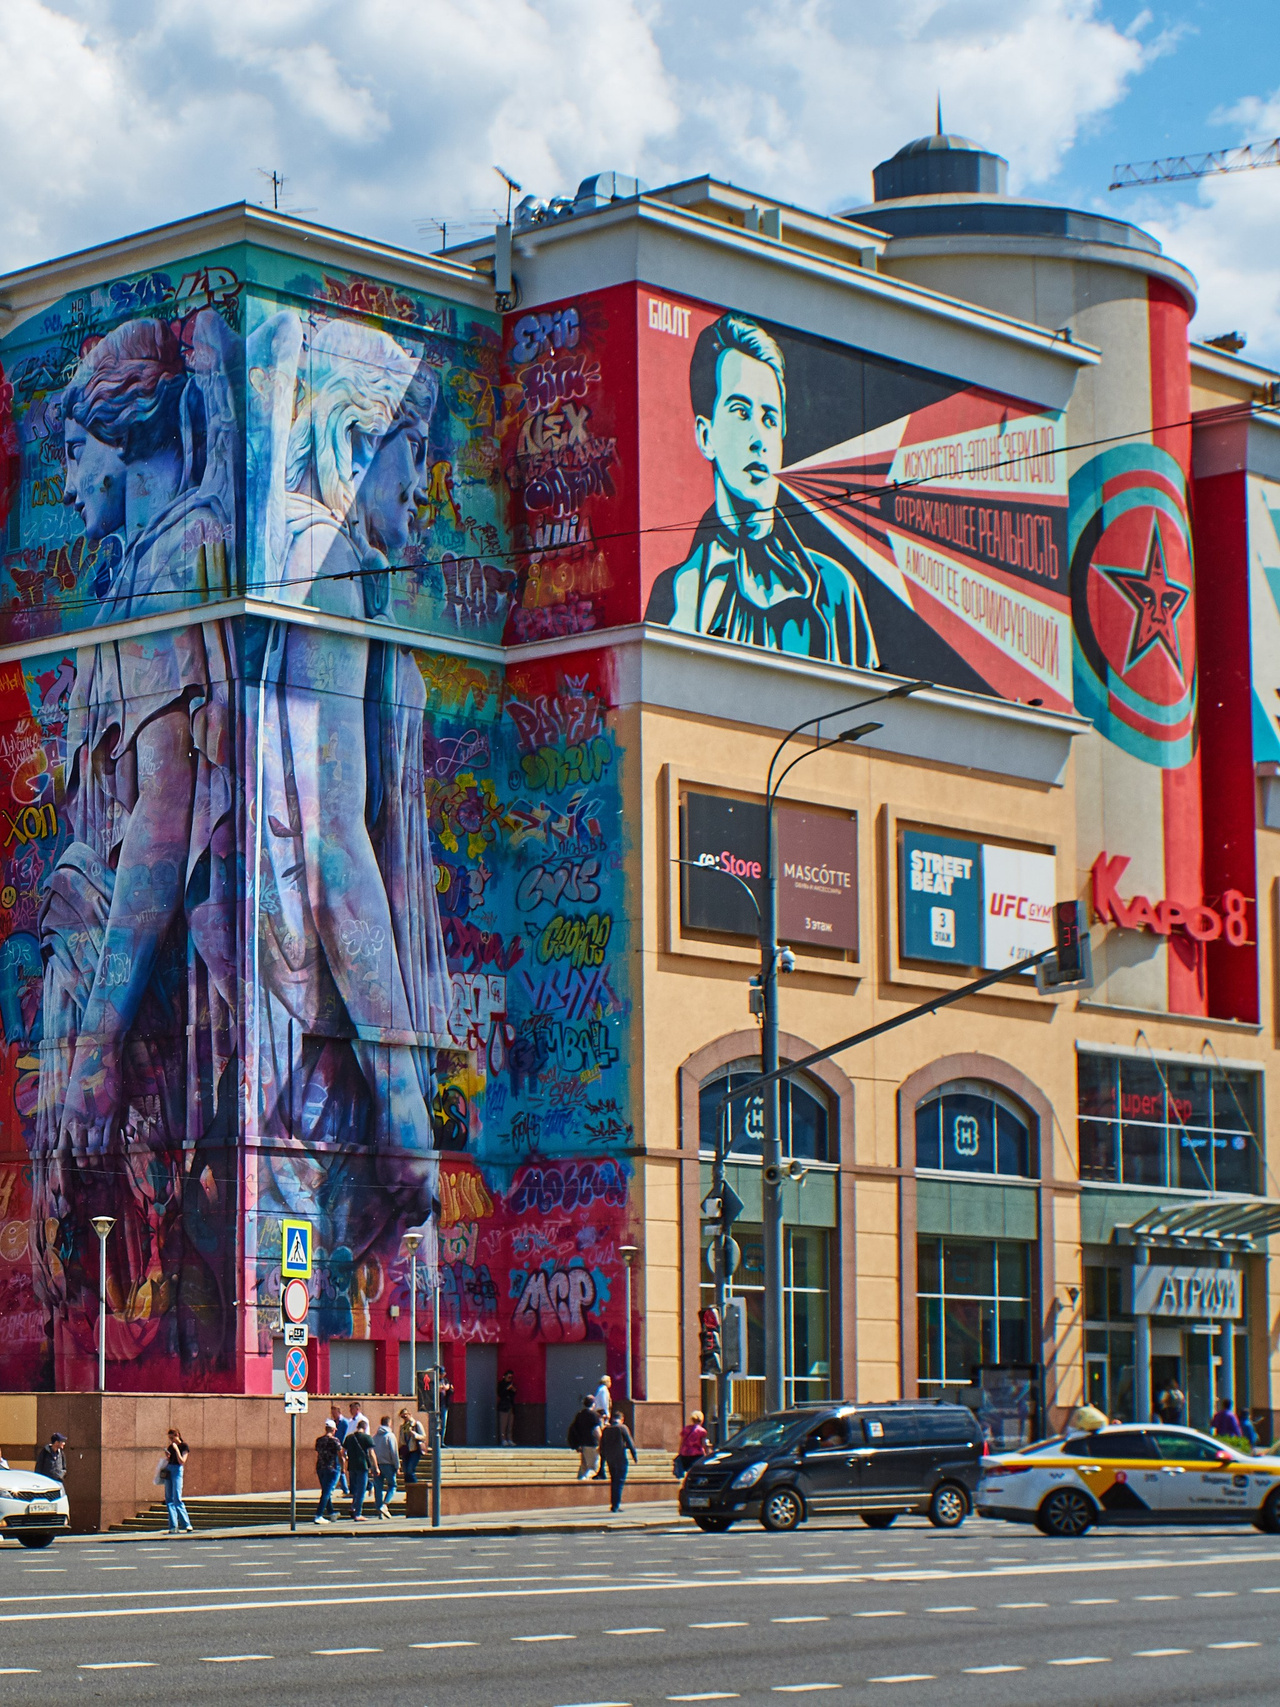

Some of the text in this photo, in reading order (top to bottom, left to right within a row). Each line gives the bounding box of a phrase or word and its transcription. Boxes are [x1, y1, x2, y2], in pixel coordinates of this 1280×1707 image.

[1004, 426, 1055, 484] ЗЕРКАЛО
[894, 495, 1059, 580] ОТРАЖАЮЩЕЕ РЕАЛЬНОСТЬ
[912, 549, 945, 596] МОЛОТ
[946, 567, 959, 608] ЕЕ
[961, 576, 1060, 681] ФОРМИРУЮЩИЙ
[699, 851, 762, 879] re:Store
[783, 862, 852, 888] MASCÓTTE
[910, 849, 973, 880] STREET
[910, 869, 955, 897] BEAT
[939, 912, 947, 928] 3
[990, 892, 1053, 920] UFC GYM
[1222, 889, 1249, 947] 8
[804, 917, 833, 933] 3 этаж
[934, 930, 952, 943] ЭТАЖ
[1111, 1087, 1193, 1125] SuperSep
